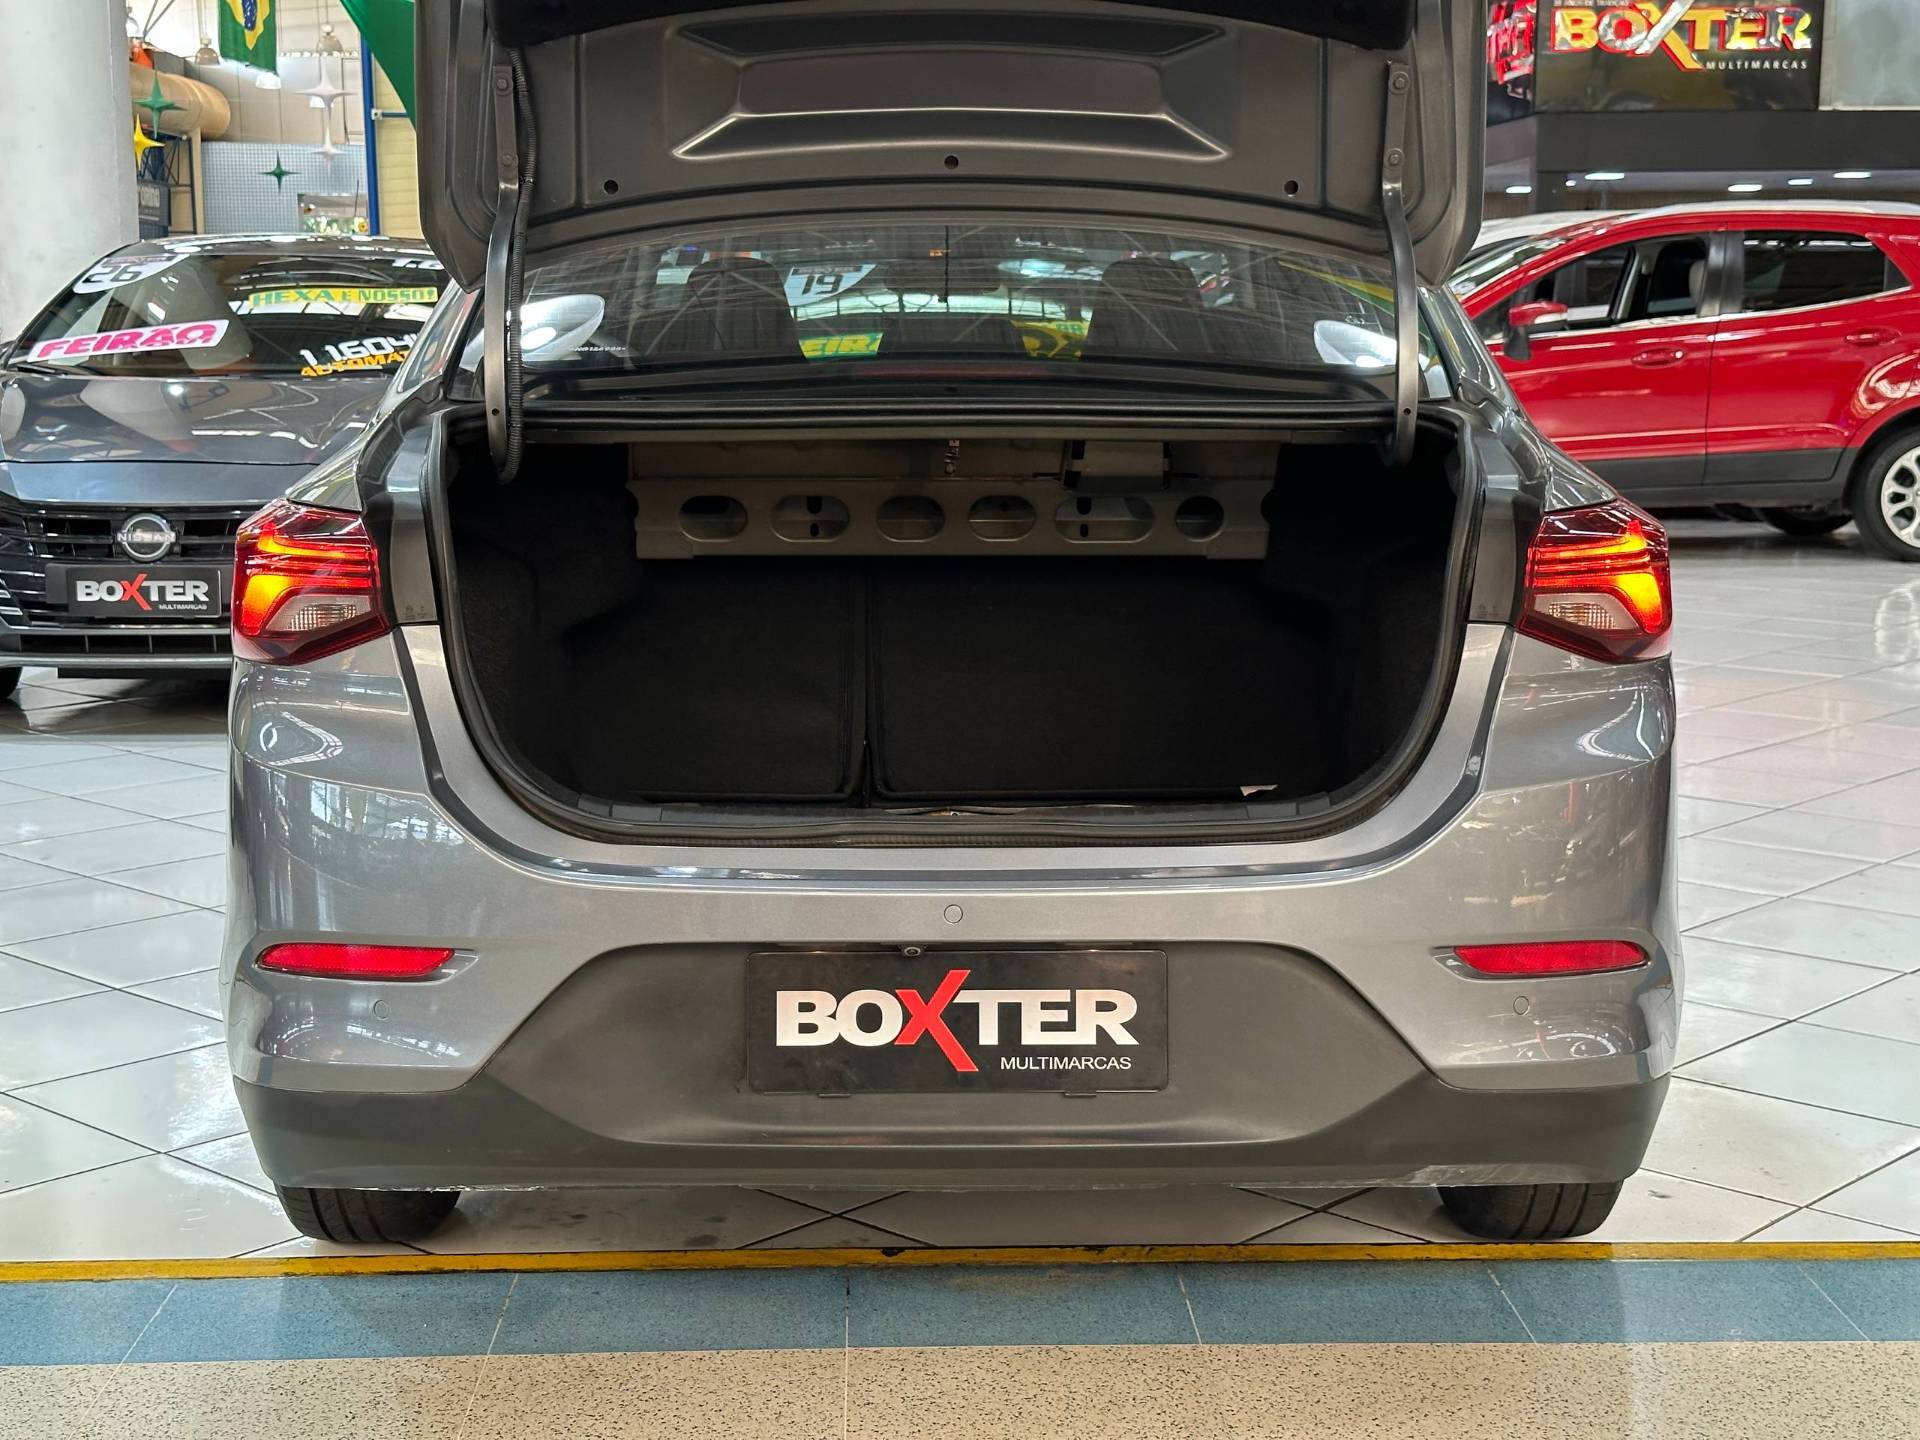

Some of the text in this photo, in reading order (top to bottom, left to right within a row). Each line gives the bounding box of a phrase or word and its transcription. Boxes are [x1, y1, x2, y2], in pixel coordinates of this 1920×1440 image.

[1550, 0, 1812, 71] BOXTER
[1706, 60, 1808, 70] MULTIMARCAS
[252, 288, 335, 307] HEXA
[358, 289, 435, 302] NOSSO!
[37, 323, 217, 359] FEIRÃO
[116, 531, 177, 543] NISSAN
[76, 573, 210, 611] BOXTER
[158, 602, 208, 611] MULTIMARCAS
[775, 969, 1140, 1072] BOXTER
[999, 1055, 1132, 1071] MULTIMARCAS
